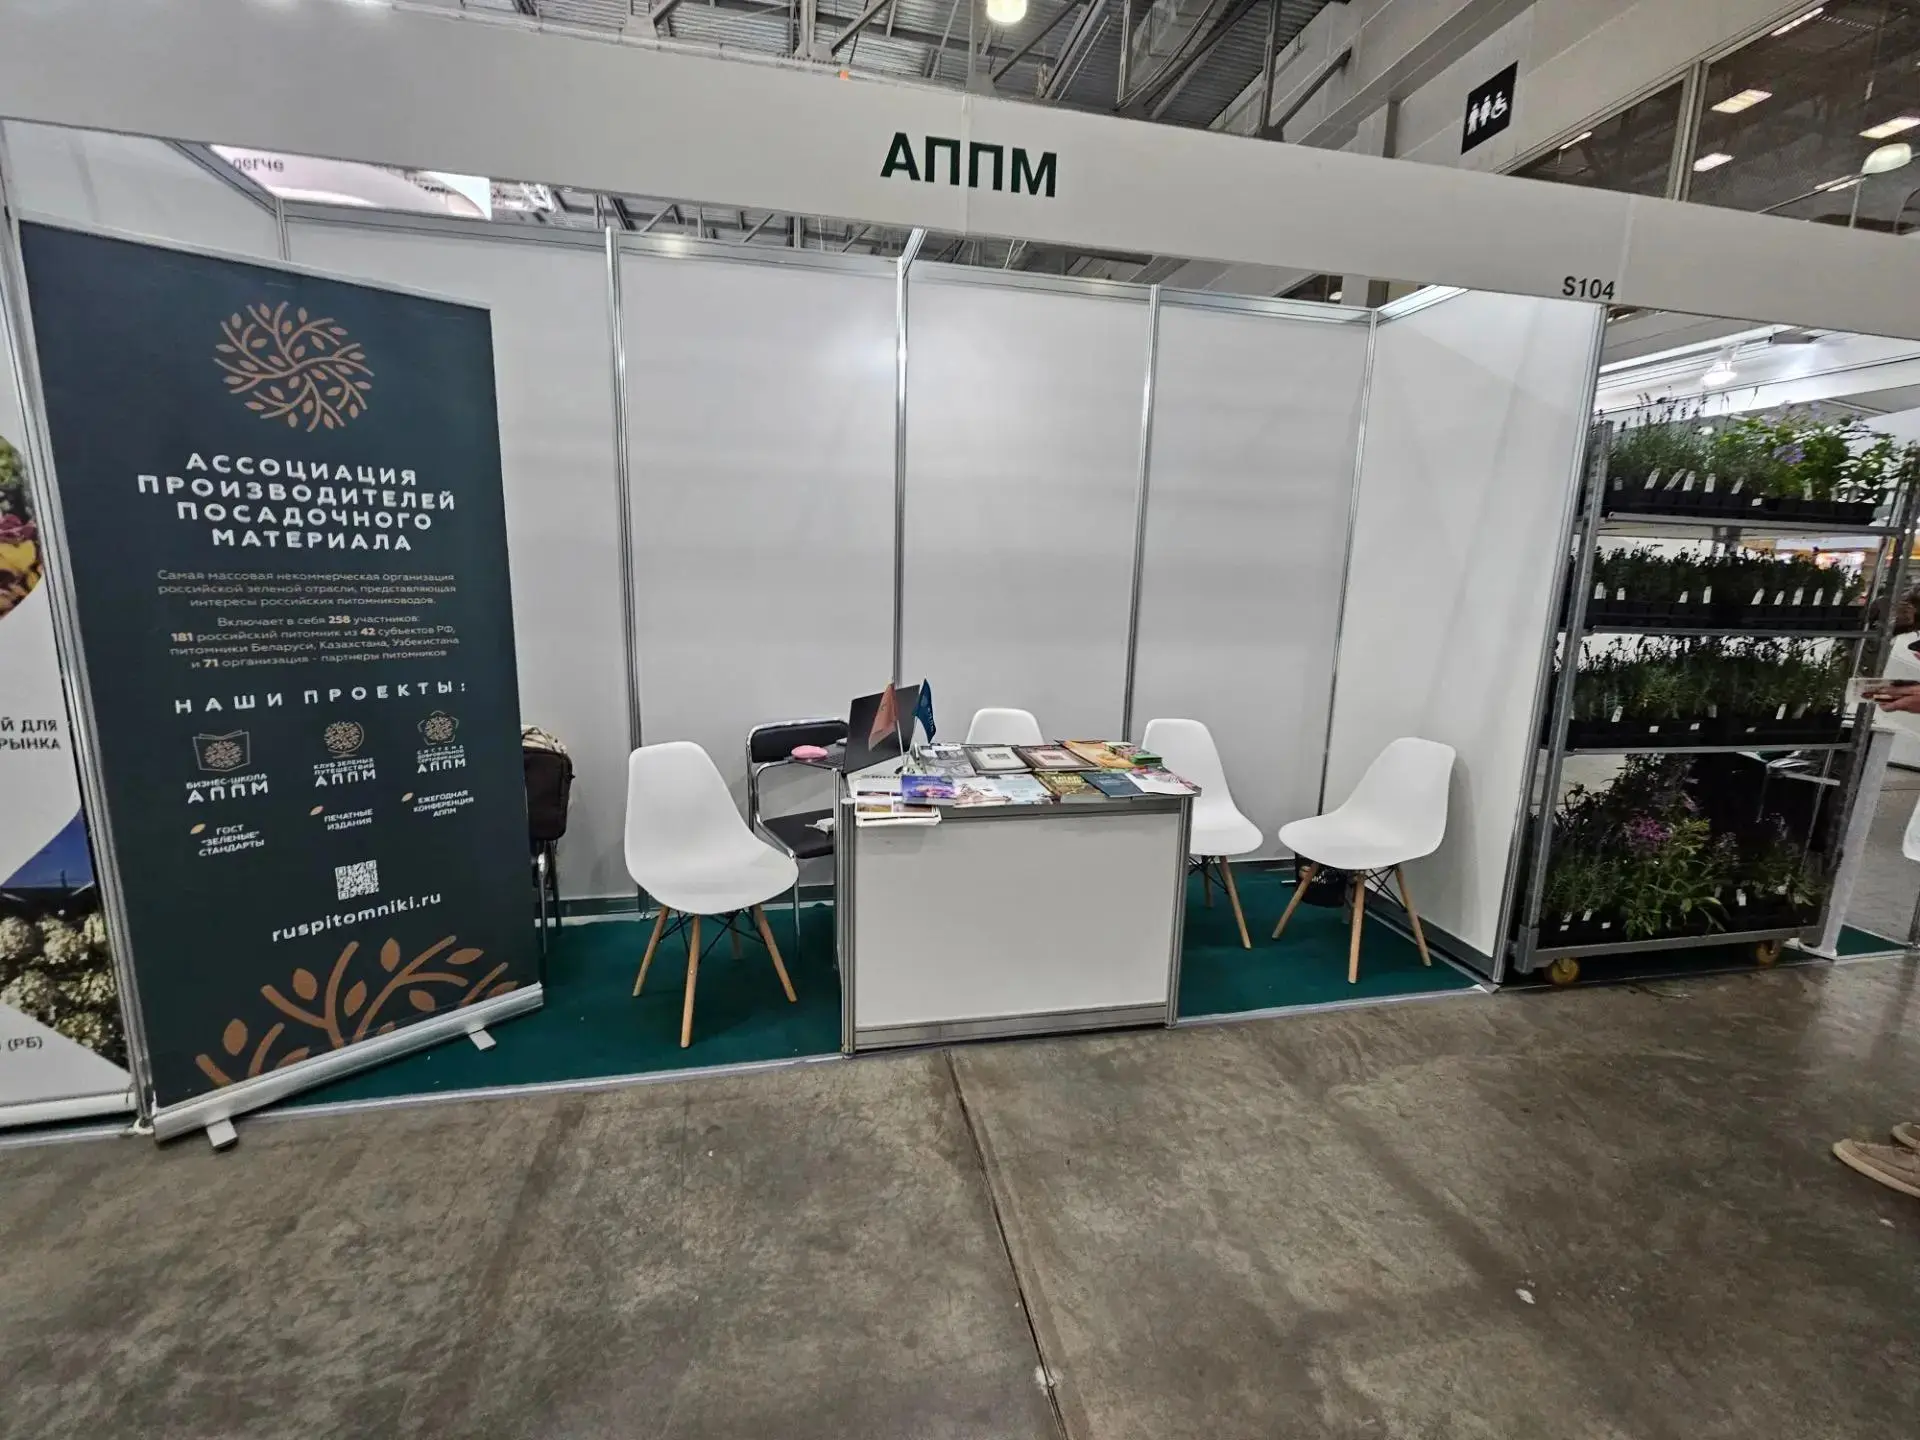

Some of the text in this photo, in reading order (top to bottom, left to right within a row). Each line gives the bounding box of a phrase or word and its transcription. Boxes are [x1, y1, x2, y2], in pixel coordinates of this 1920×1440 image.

[880, 132, 1057, 198] АППМ
[1562, 276, 1615, 300] S104
[185, 453, 415, 485] АССОЦИАЦИЯ
[137, 475, 454, 510] ПРОИЗВОДИТЕЛЕЙ
[177, 502, 431, 530] ПОСАДОЧНОГО
[211, 528, 411, 551] МАТЕРИАЛА
[157, 570, 455, 582] Самая массовая некоммерческая организация
[158, 584, 243, 594] российской
[247, 584, 302, 593] зеленой
[360, 585, 456, 594] представляющая
[190, 597, 257, 607] интересы
[260, 596, 334, 606] российских
[217, 617, 284, 627] Включает
[297, 616, 325, 625] себя
[328, 615, 351, 624] 258
[170, 632, 194, 642] 181
[196, 630, 277, 643] российский
[280, 628, 340, 639] питомник
[360, 628, 376, 636] 42
[170, 645, 248, 655] питомники
[392, 638, 460, 647] Узбекистана
[202, 659, 218, 668] 71
[321, 653, 380, 663] партнеры
[383, 650, 447, 659] питомников
[175, 681, 465, 714] НАШИ ПРОЕКТЫ:
[21, 719, 57, 733] ДЛЯ
[0, 737, 61, 750] РЫНКА
[313, 757, 374, 770] КЛУБ ЗЕЛЕНЫХ
[314, 763, 374, 775] ПУТЕШЕСТВИЙ
[417, 758, 466, 774] АППМ
[186, 773, 267, 789] БИЗНЕС-ШКОЛА
[315, 769, 376, 788] АППМ
[187, 780, 268, 804] АППМ
[418, 790, 469, 804] ЕЖЕГОДНАЯ
[413, 797, 474, 812] КОНФЕРЕНЦИЯ
[324, 808, 374, 823] ПЕЧАТНЫЕ
[433, 808, 457, 817] АППМ
[216, 824, 244, 835] ГОСТ
[327, 817, 372, 831] ИЗДАНИЯ
[198, 840, 264, 857] СТАНДАРТЫ
[272, 893, 441, 942] ruspitomniki.ru
[8, 1036, 42, 1051] (РБ)
